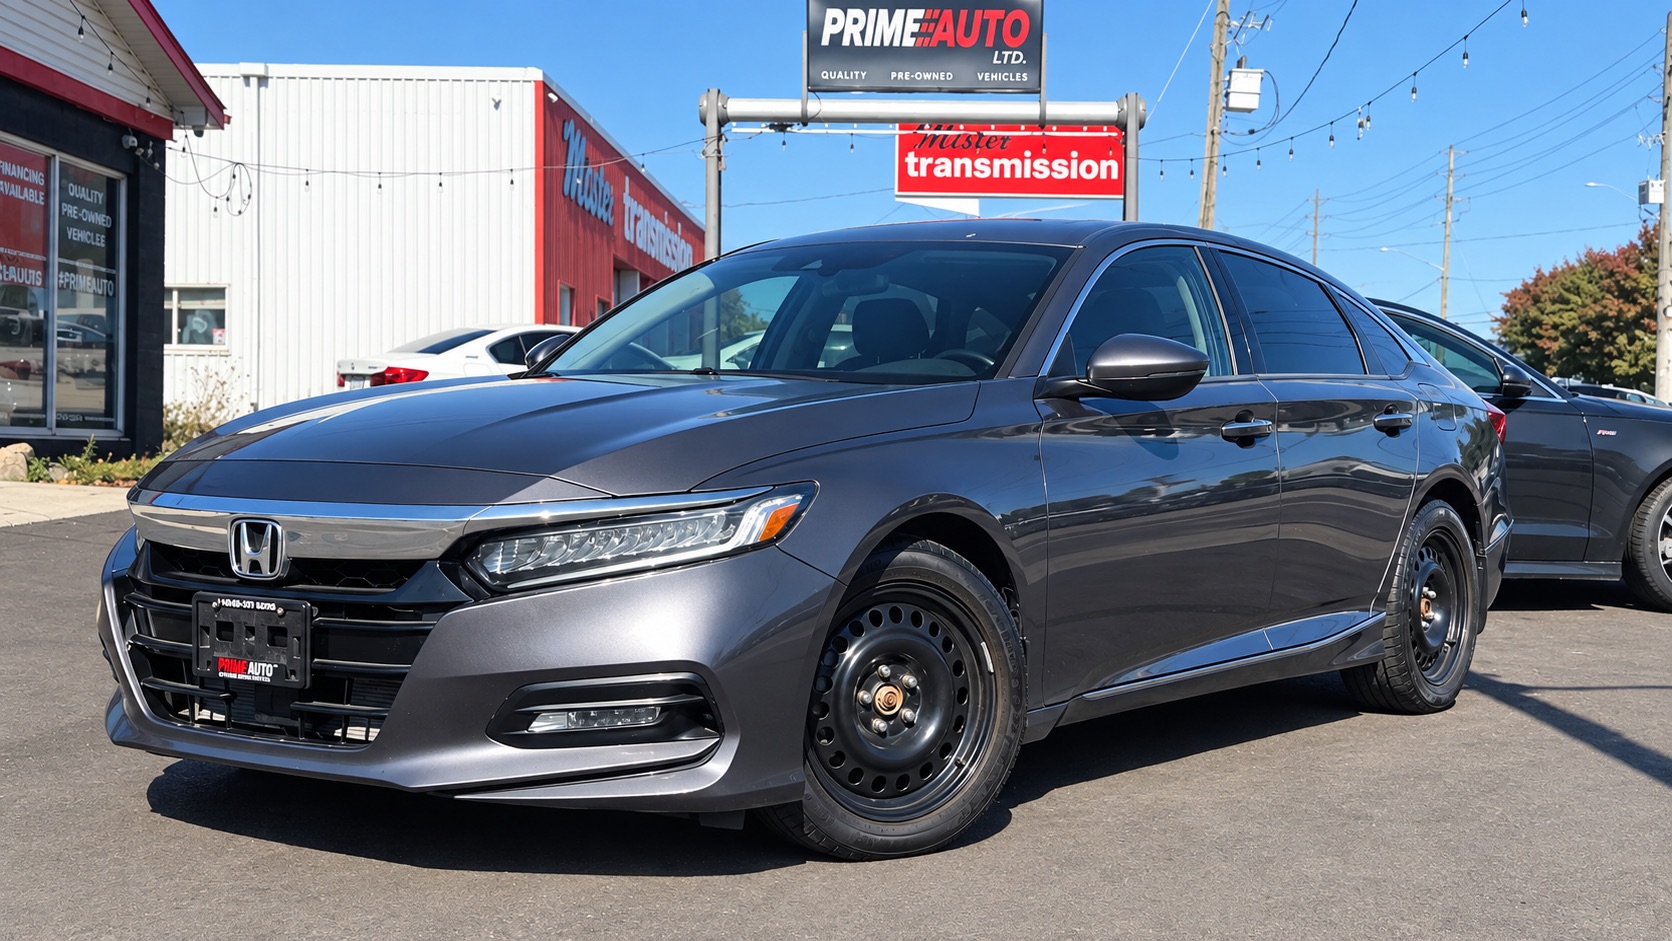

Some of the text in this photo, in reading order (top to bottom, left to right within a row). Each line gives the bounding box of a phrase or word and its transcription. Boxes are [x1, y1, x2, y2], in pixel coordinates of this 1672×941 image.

[992, 50, 1027, 65] LTD.
[821, 70, 1028, 82] QUALITY PRE-OWNED VEHICLES
[904, 150, 1119, 180] transmission
[68, 182, 104, 205] QUALITY
[61, 202, 113, 228] PRE-OWNED
[623, 175, 694, 273] transmission
[58, 270, 115, 297] #PRIMEAUTO
[217, 656, 248, 675] PRIME
[247, 661, 273, 678] AUTO
